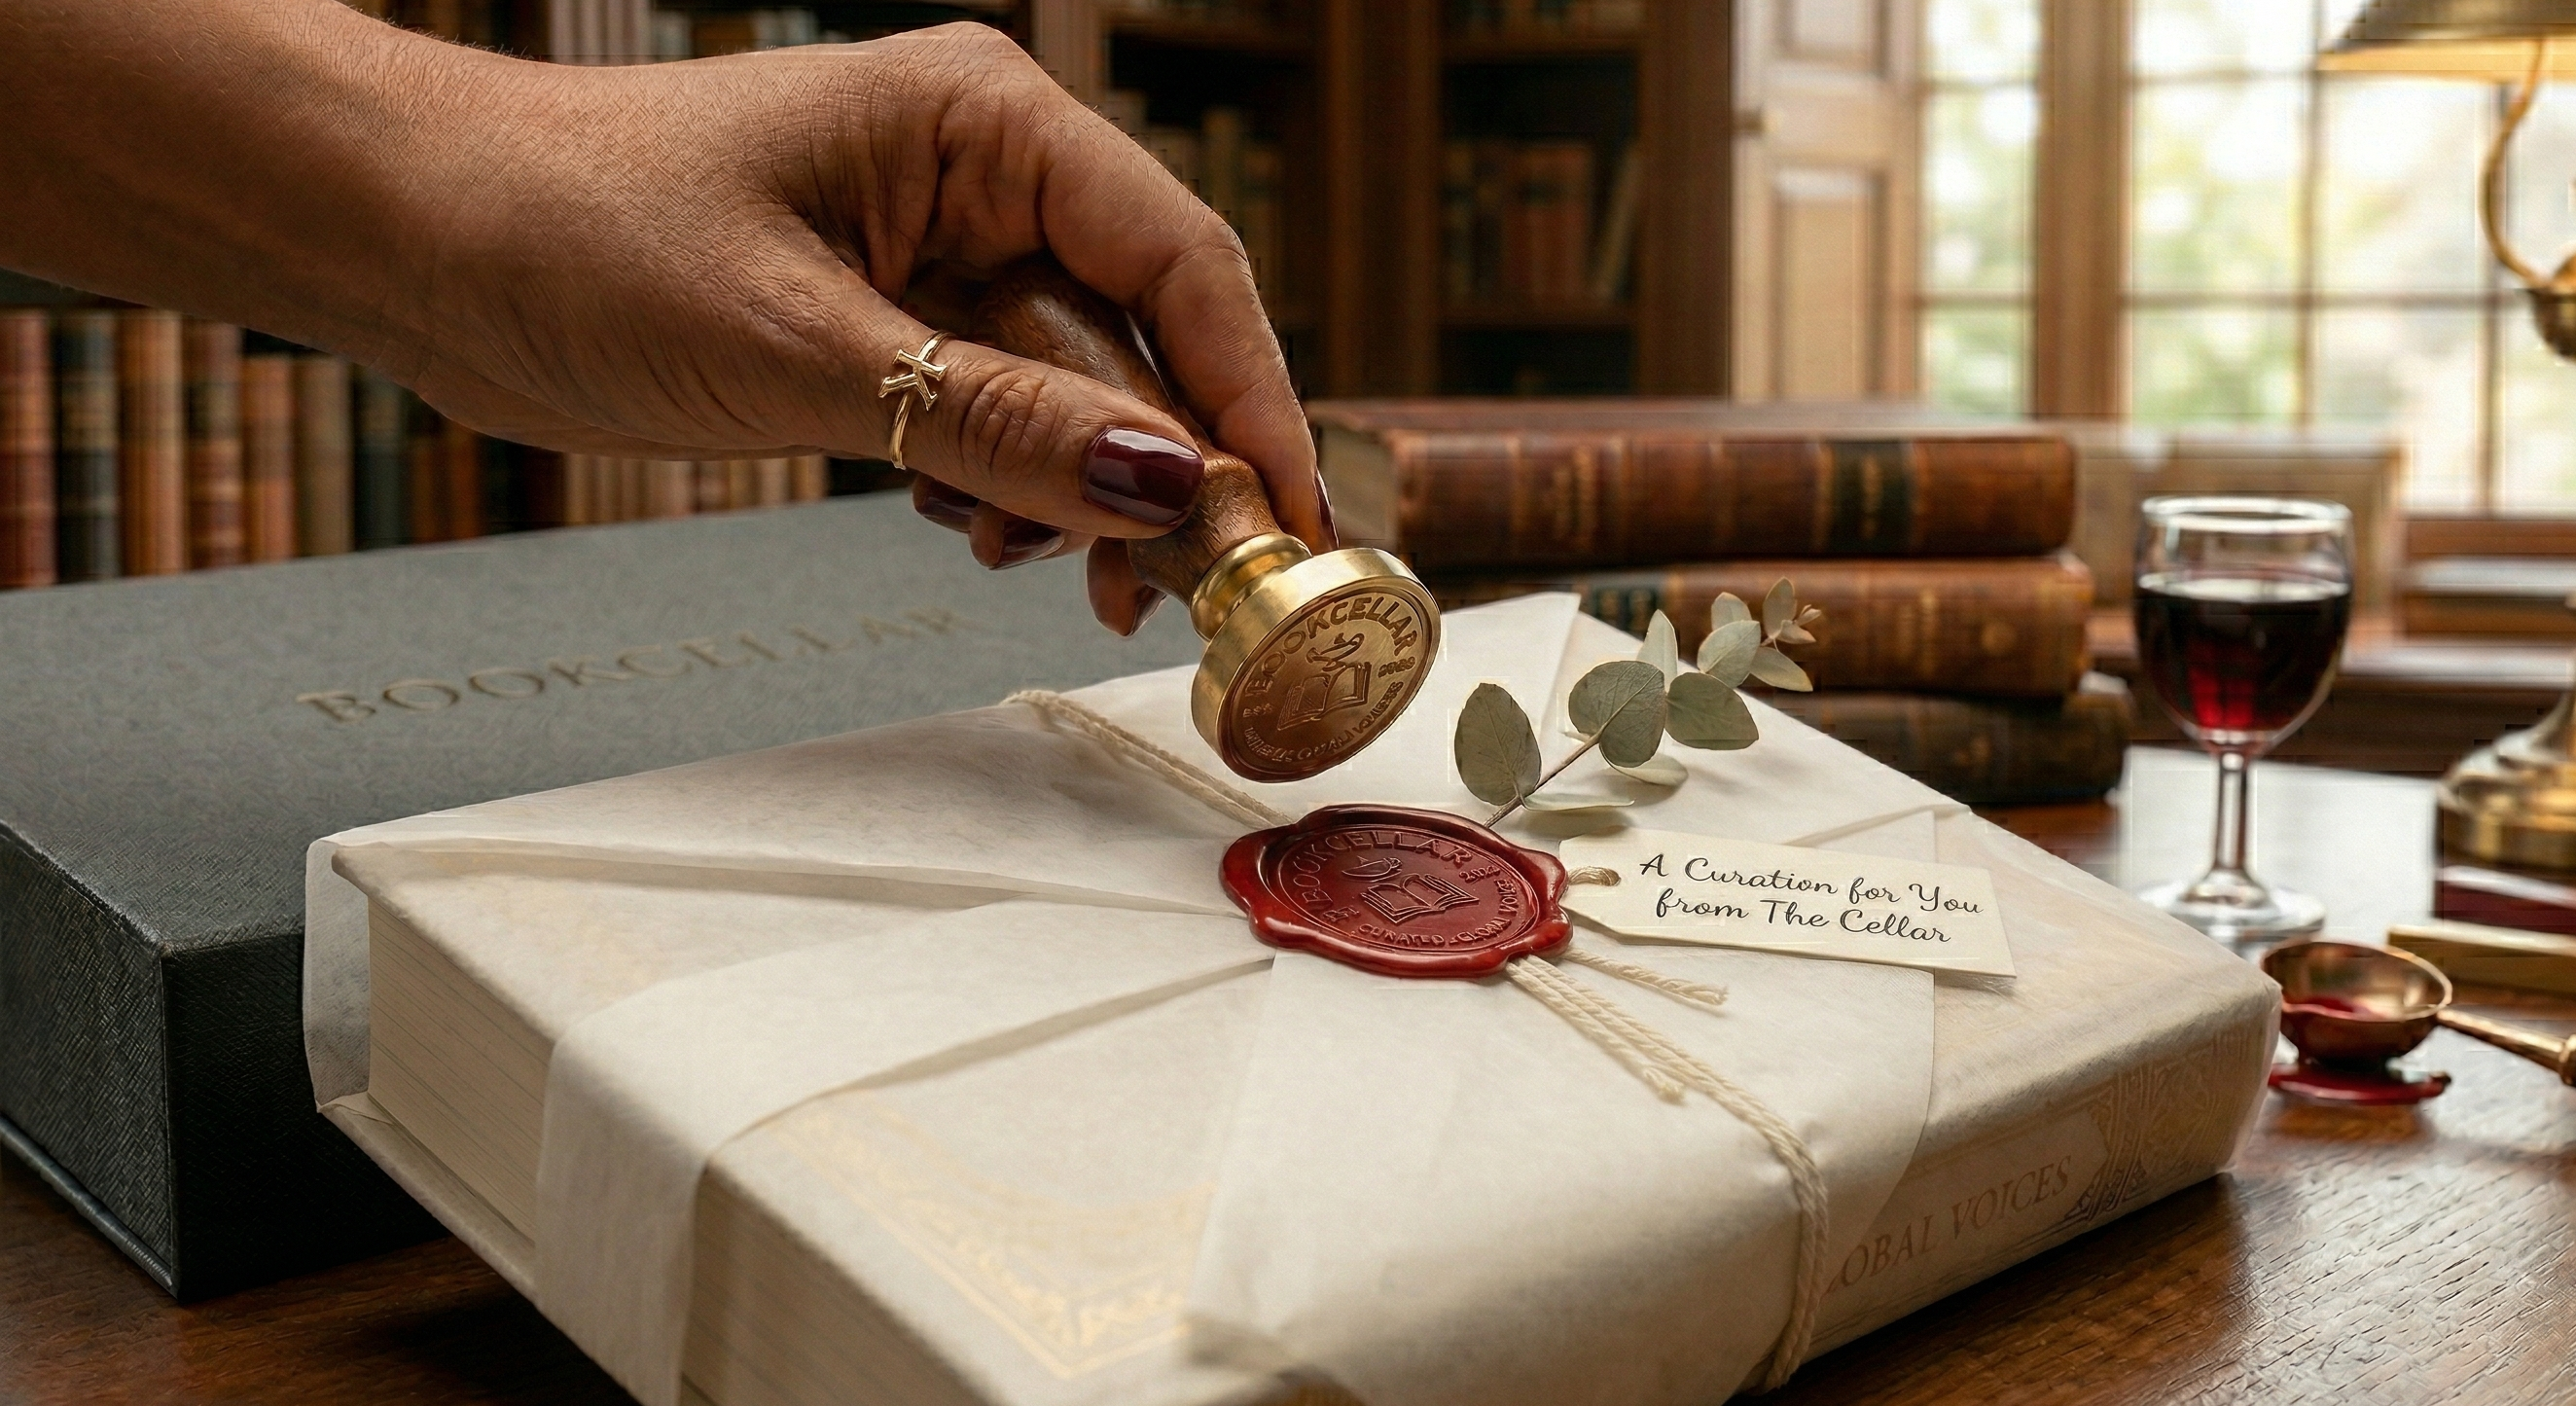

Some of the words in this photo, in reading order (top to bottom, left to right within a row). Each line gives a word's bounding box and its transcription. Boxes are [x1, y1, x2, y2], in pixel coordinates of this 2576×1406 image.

[1639, 853, 1667, 878] A
[1685, 858, 1838, 896] Curation
[1849, 877, 1900, 904] for
[1909, 883, 1984, 914] You
[1657, 887, 1748, 919] from
[1760, 899, 1830, 928] The
[1840, 909, 1951, 943] Cellar
[1825, 1215, 1938, 1292] OBAL
[1950, 1155, 2073, 1241] VOICES
